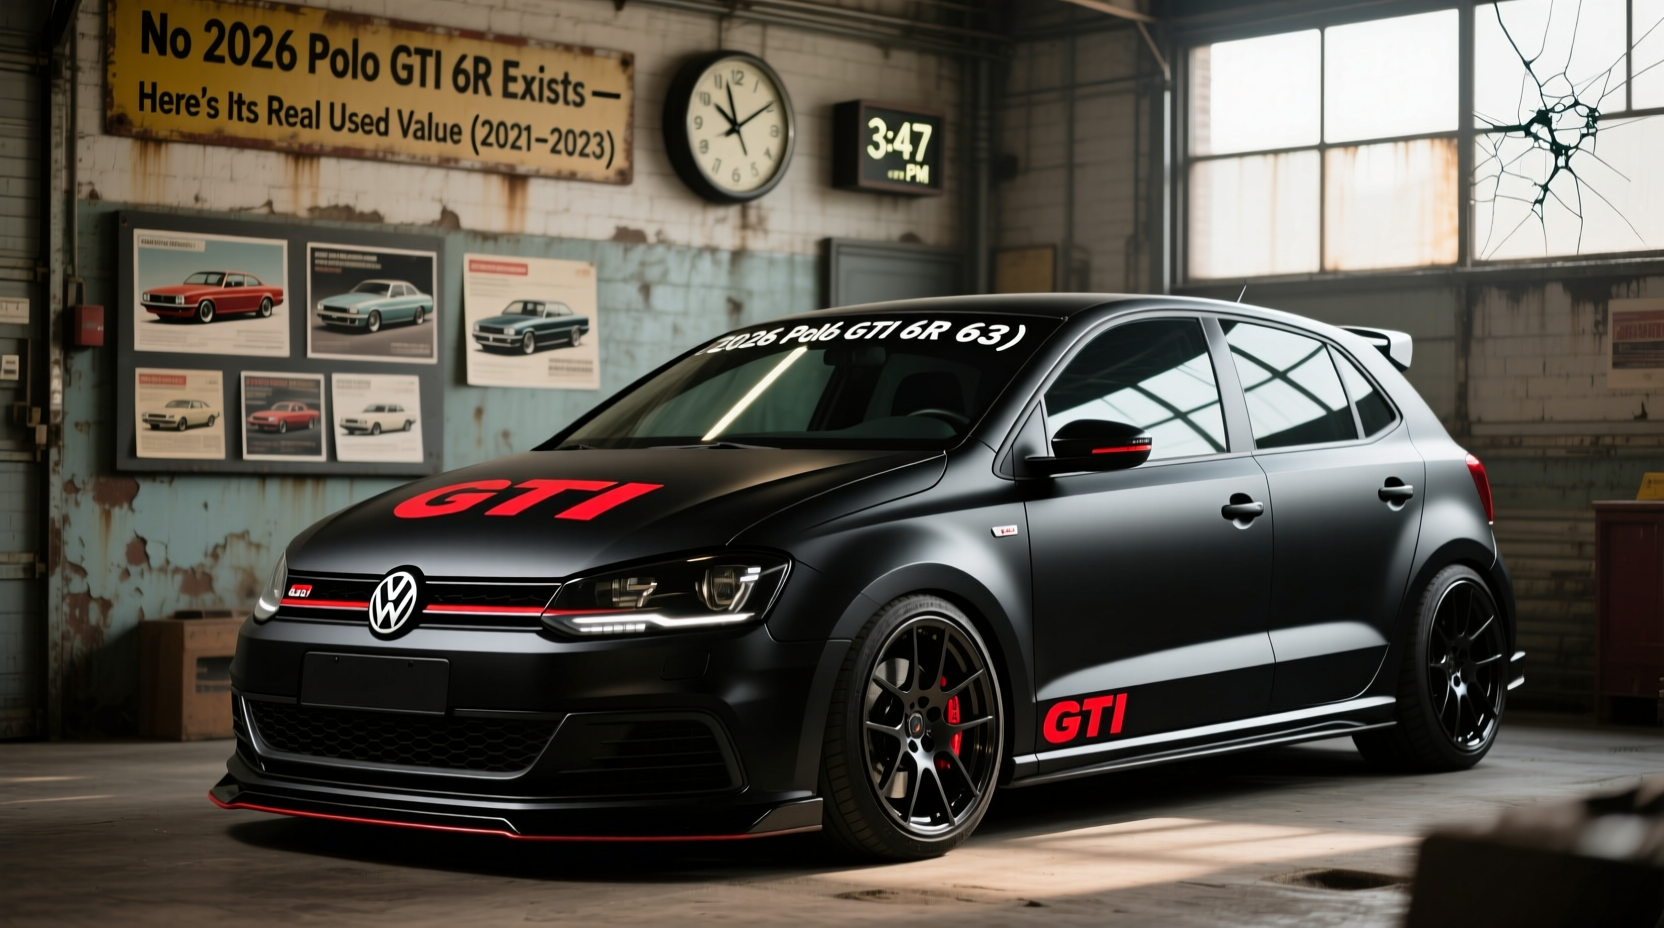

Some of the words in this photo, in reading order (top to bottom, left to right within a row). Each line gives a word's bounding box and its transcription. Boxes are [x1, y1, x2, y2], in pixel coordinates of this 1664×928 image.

[140, 10, 192, 60] No
[202, 18, 298, 72] 2026
[307, 32, 380, 82] Polo
[390, 44, 442, 92] GTI
[452, 53, 492, 97] 6R
[731, 69, 744, 87] 12
[228, 91, 259, 124] Its
[267, 95, 320, 130] Real
[329, 102, 390, 137] Used
[398, 109, 463, 145] Value
[867, 117, 933, 162] 3:47
[732, 168, 741, 183] 6
[905, 163, 930, 184] PM
[844, 321, 902, 340] GTI
[900, 320, 952, 340] 6R
[955, 322, 1026, 351] 63)
[393, 479, 664, 520] GTI
[1043, 693, 1127, 744] GTI
